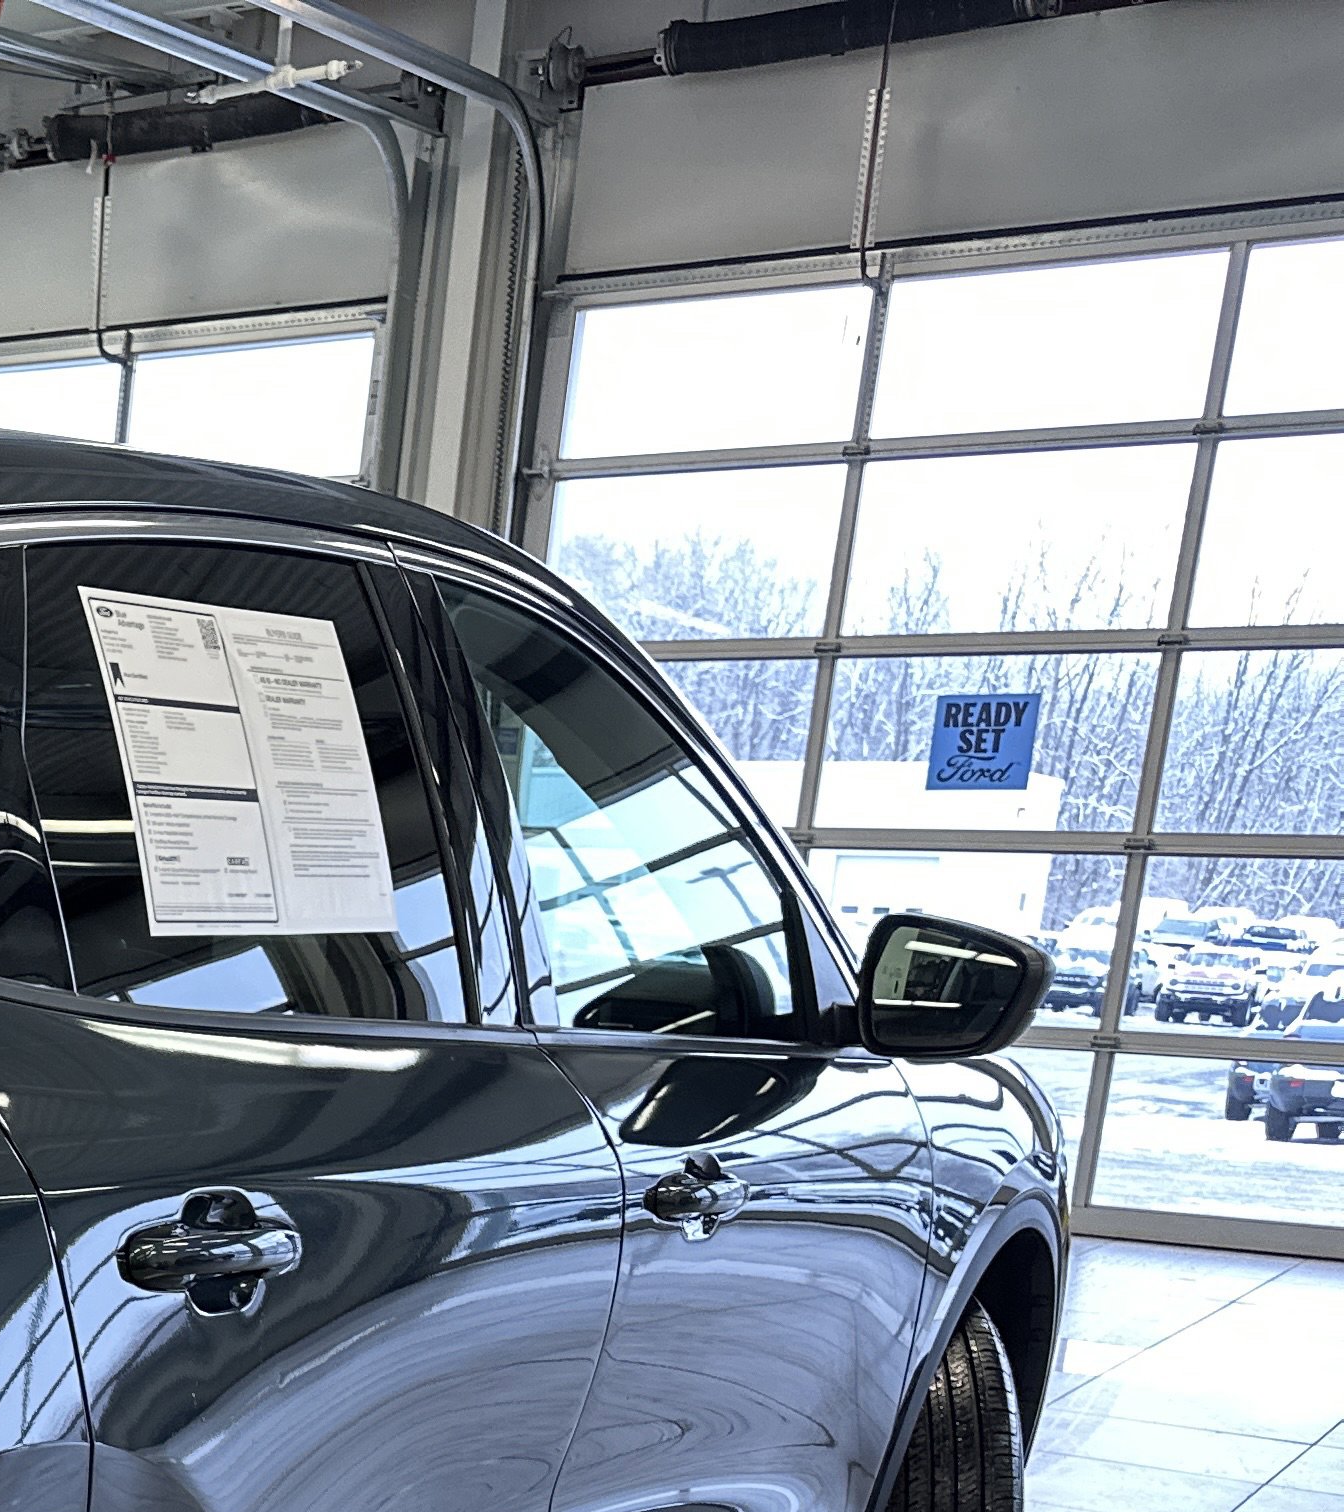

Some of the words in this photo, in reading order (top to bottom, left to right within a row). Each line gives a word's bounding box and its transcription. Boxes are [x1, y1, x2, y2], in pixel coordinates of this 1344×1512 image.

[943, 701, 1030, 728] READY
[957, 729, 1006, 753] SET
[936, 754, 1016, 783] Ford
